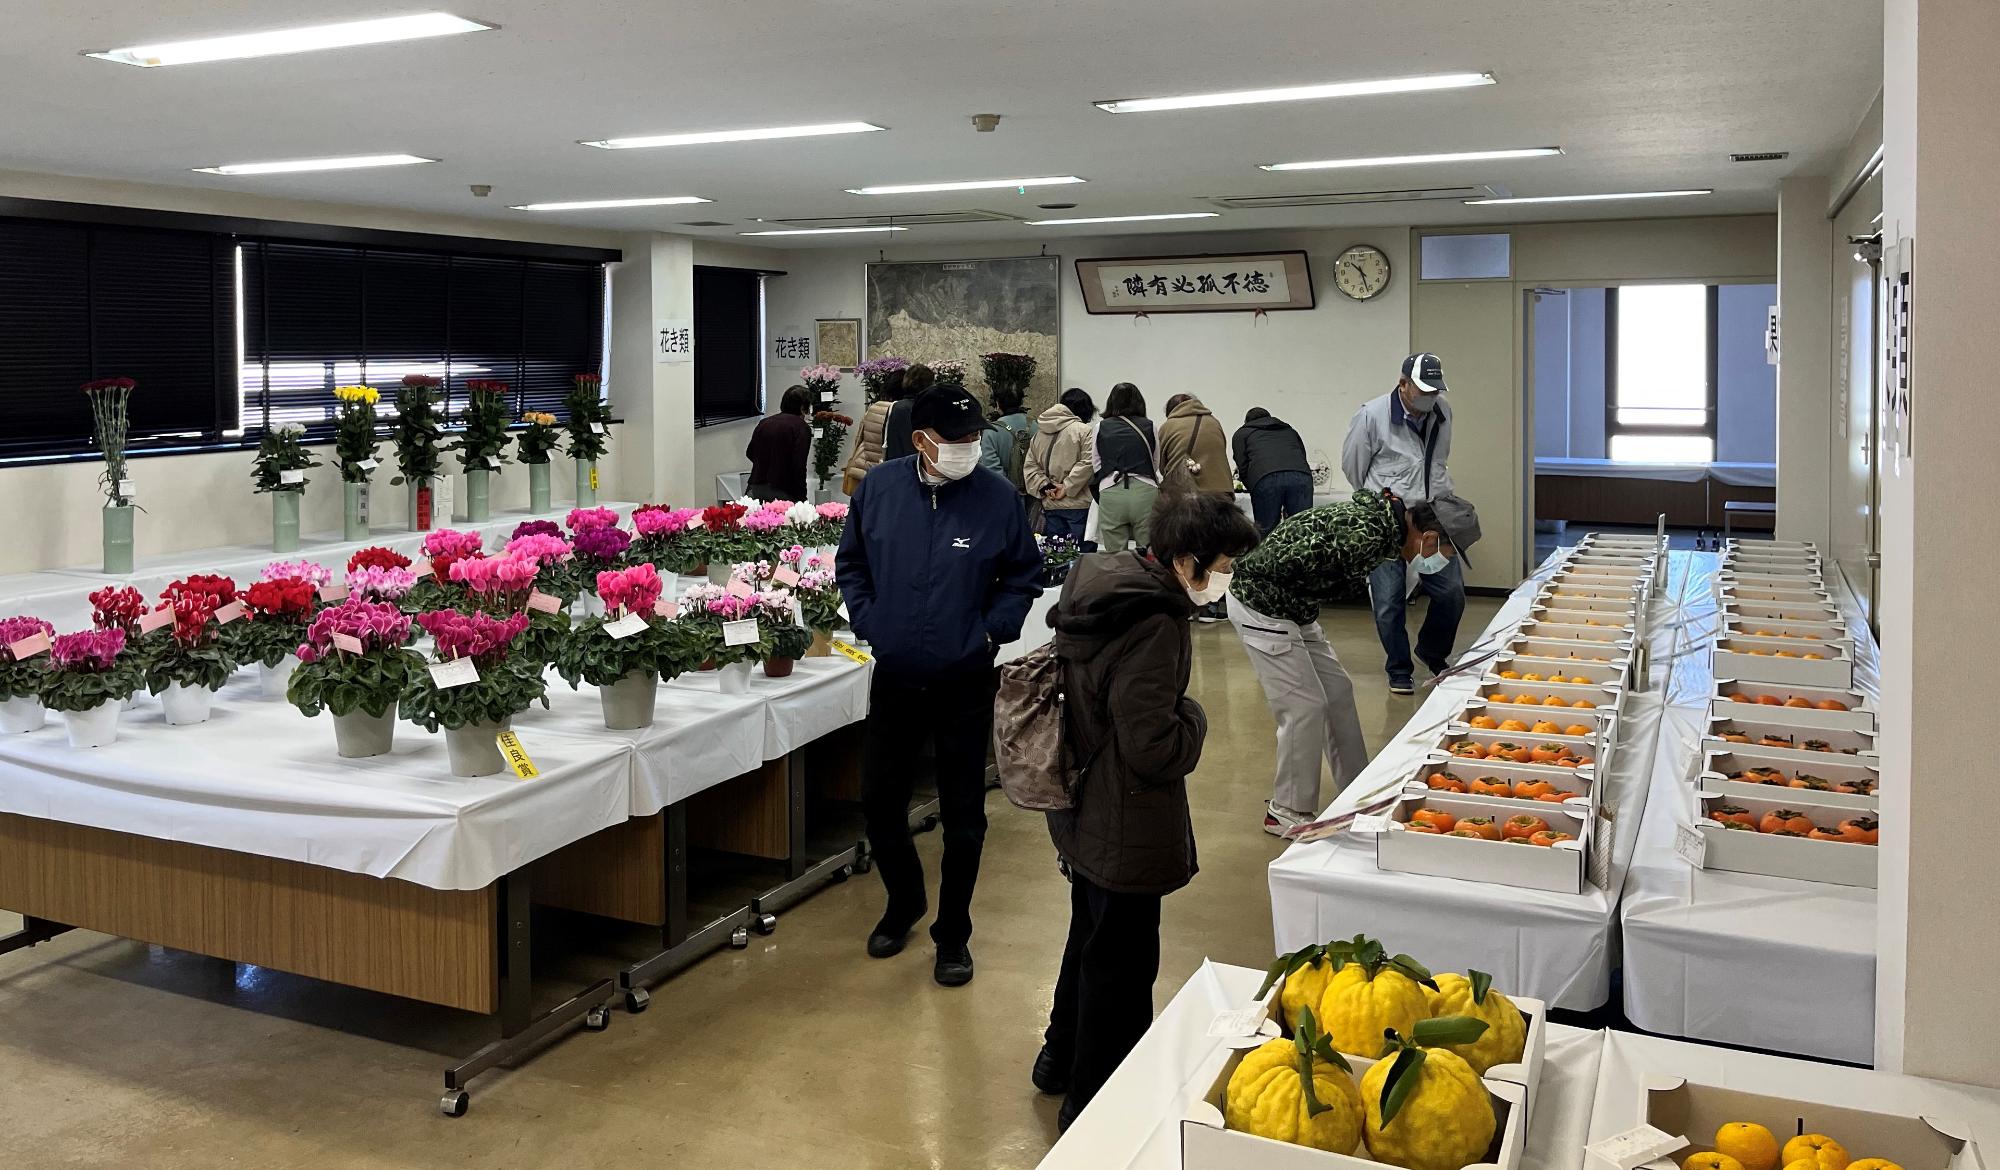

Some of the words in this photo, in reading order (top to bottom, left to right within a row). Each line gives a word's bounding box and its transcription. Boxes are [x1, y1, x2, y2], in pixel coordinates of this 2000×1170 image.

[660, 327, 690, 354] 花き類
[775, 336, 810, 360] 花き類
